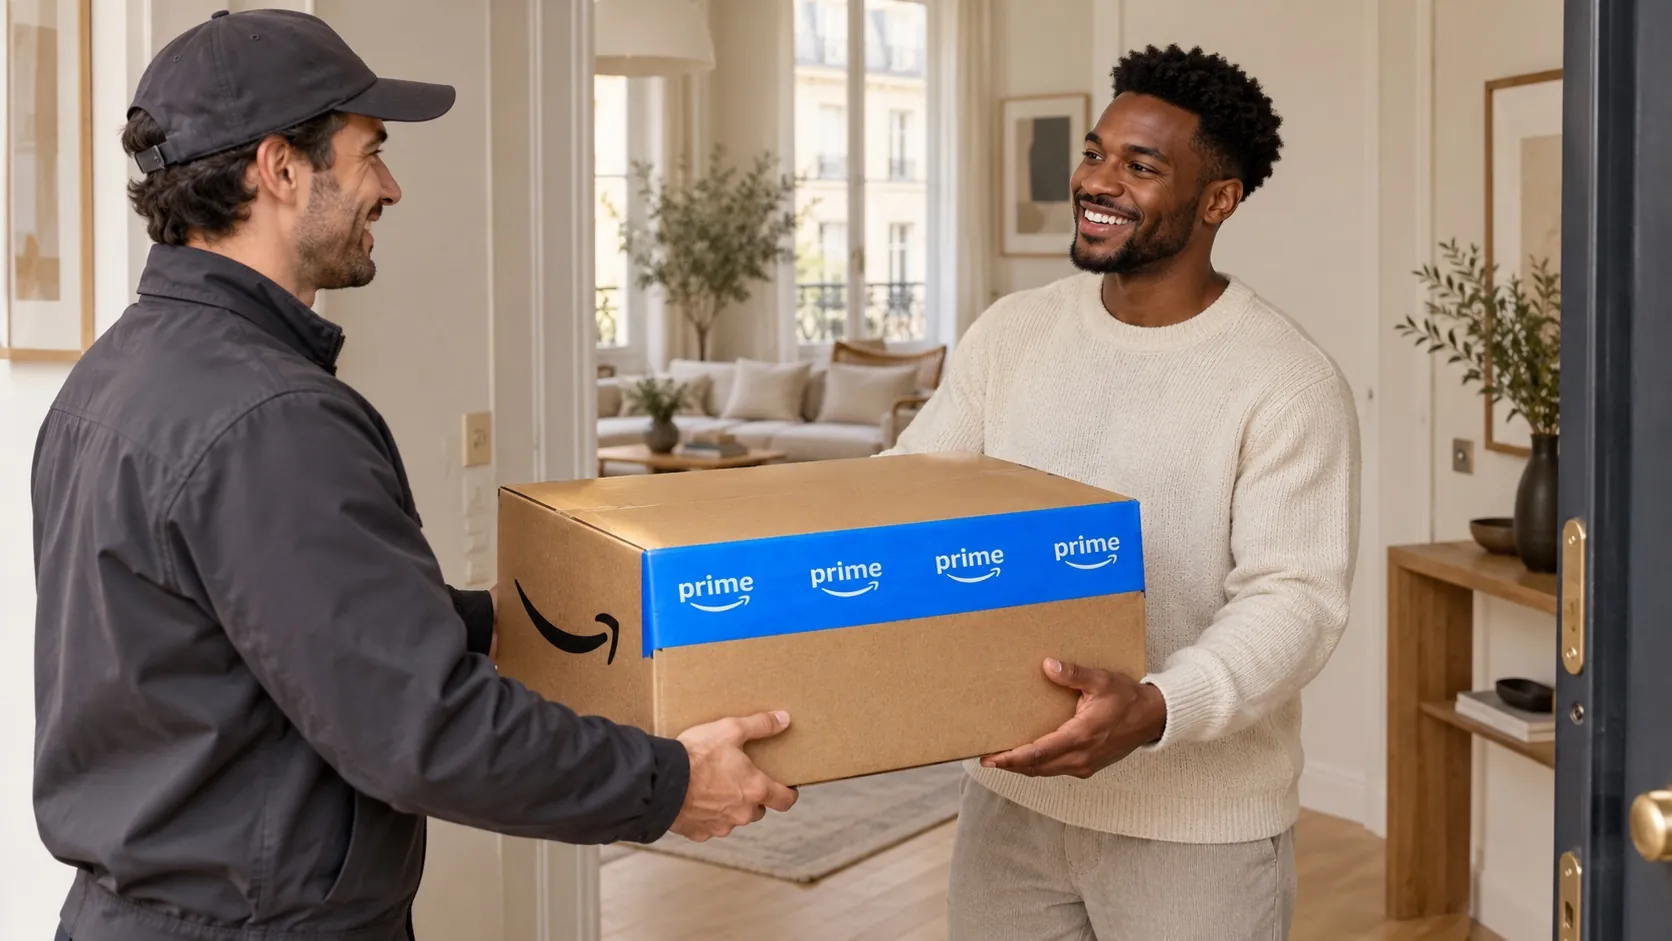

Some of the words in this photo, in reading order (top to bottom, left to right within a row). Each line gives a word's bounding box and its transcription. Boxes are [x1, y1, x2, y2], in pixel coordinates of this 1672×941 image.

[935, 547, 1004, 575] prime
[1054, 534, 1121, 561] prime
[678, 574, 754, 603] prime
[810, 560, 883, 589] prime
